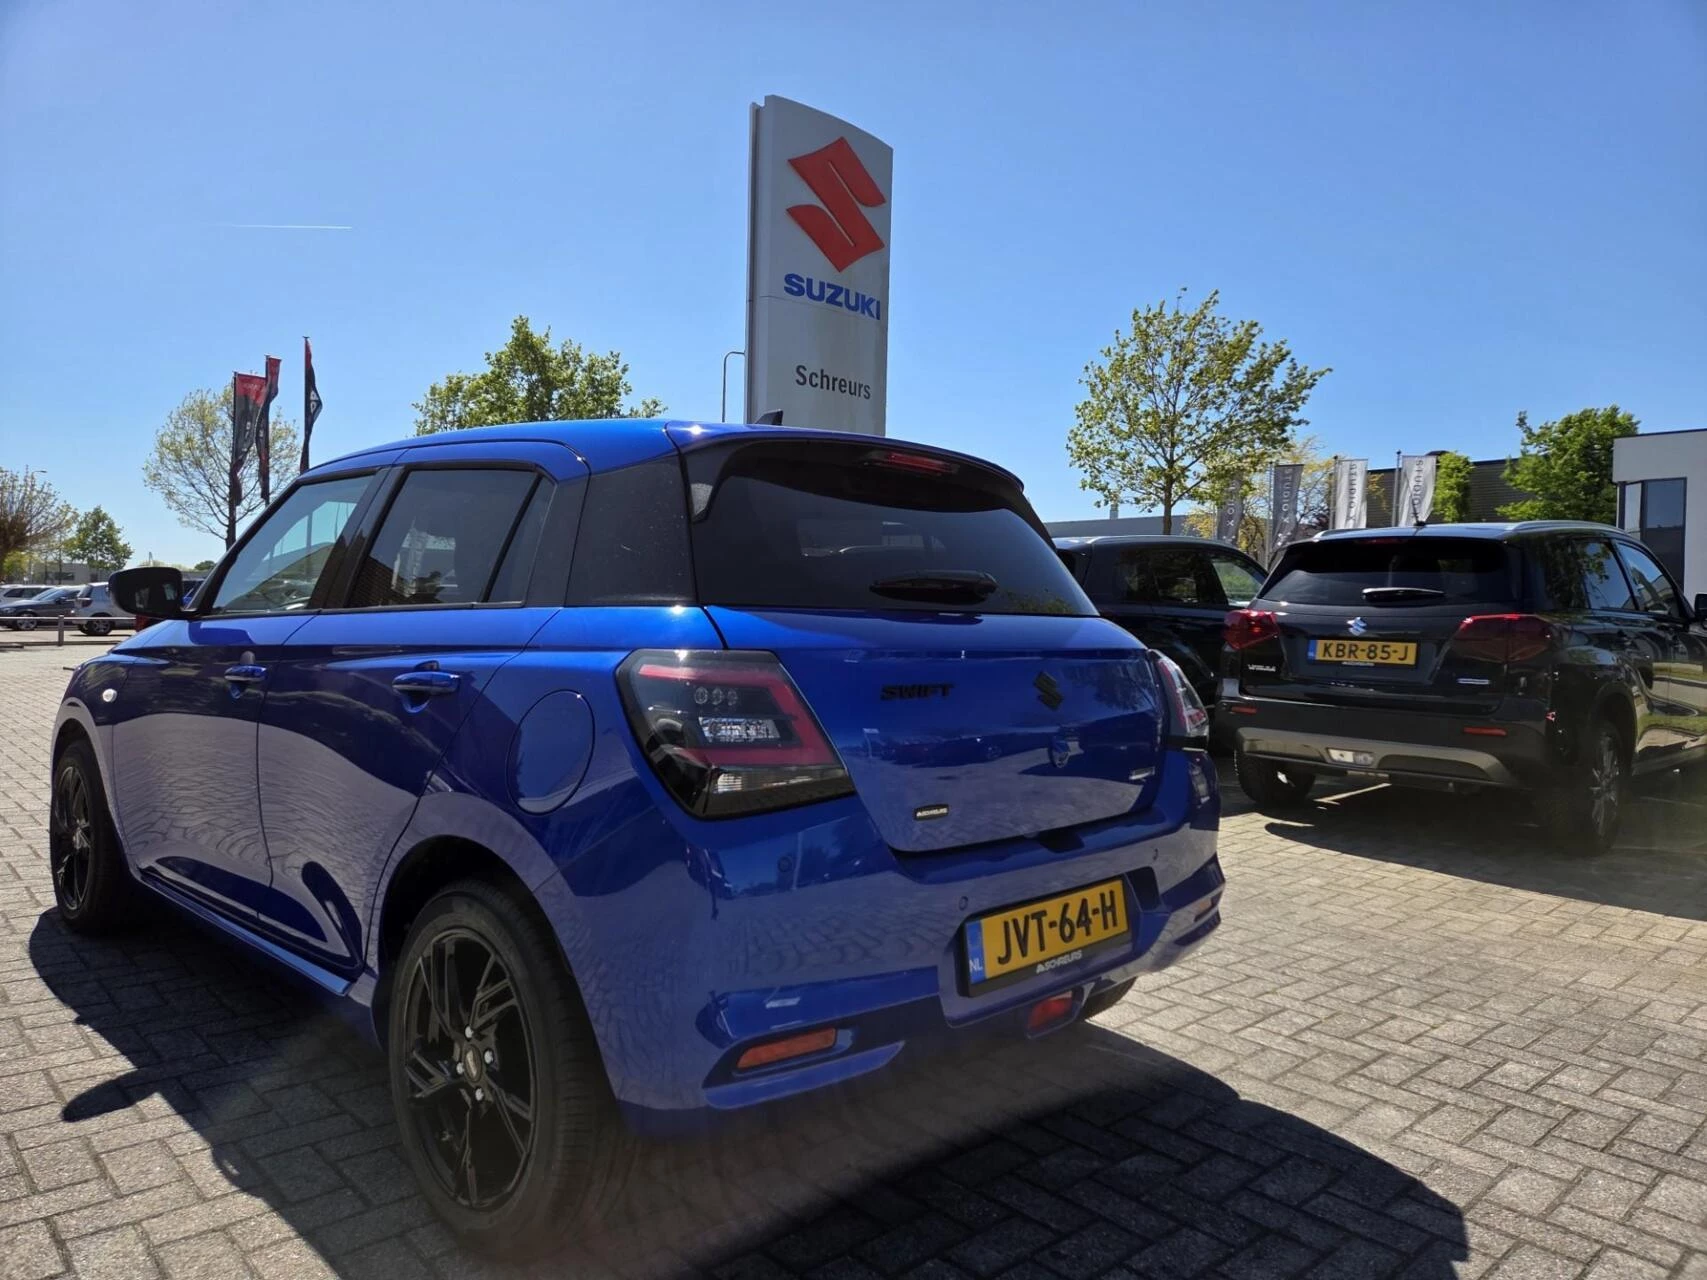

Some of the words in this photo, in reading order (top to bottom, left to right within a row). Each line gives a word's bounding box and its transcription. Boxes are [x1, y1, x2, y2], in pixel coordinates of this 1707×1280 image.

[784, 272, 881, 321] SUZUKI
[795, 364, 872, 400] Schreurs
[1322, 641, 1409, 661] KBR-85-J
[880, 683, 955, 700] SWIFT
[997, 889, 1118, 966] JVT-64-H
[969, 957, 983, 972] NL
